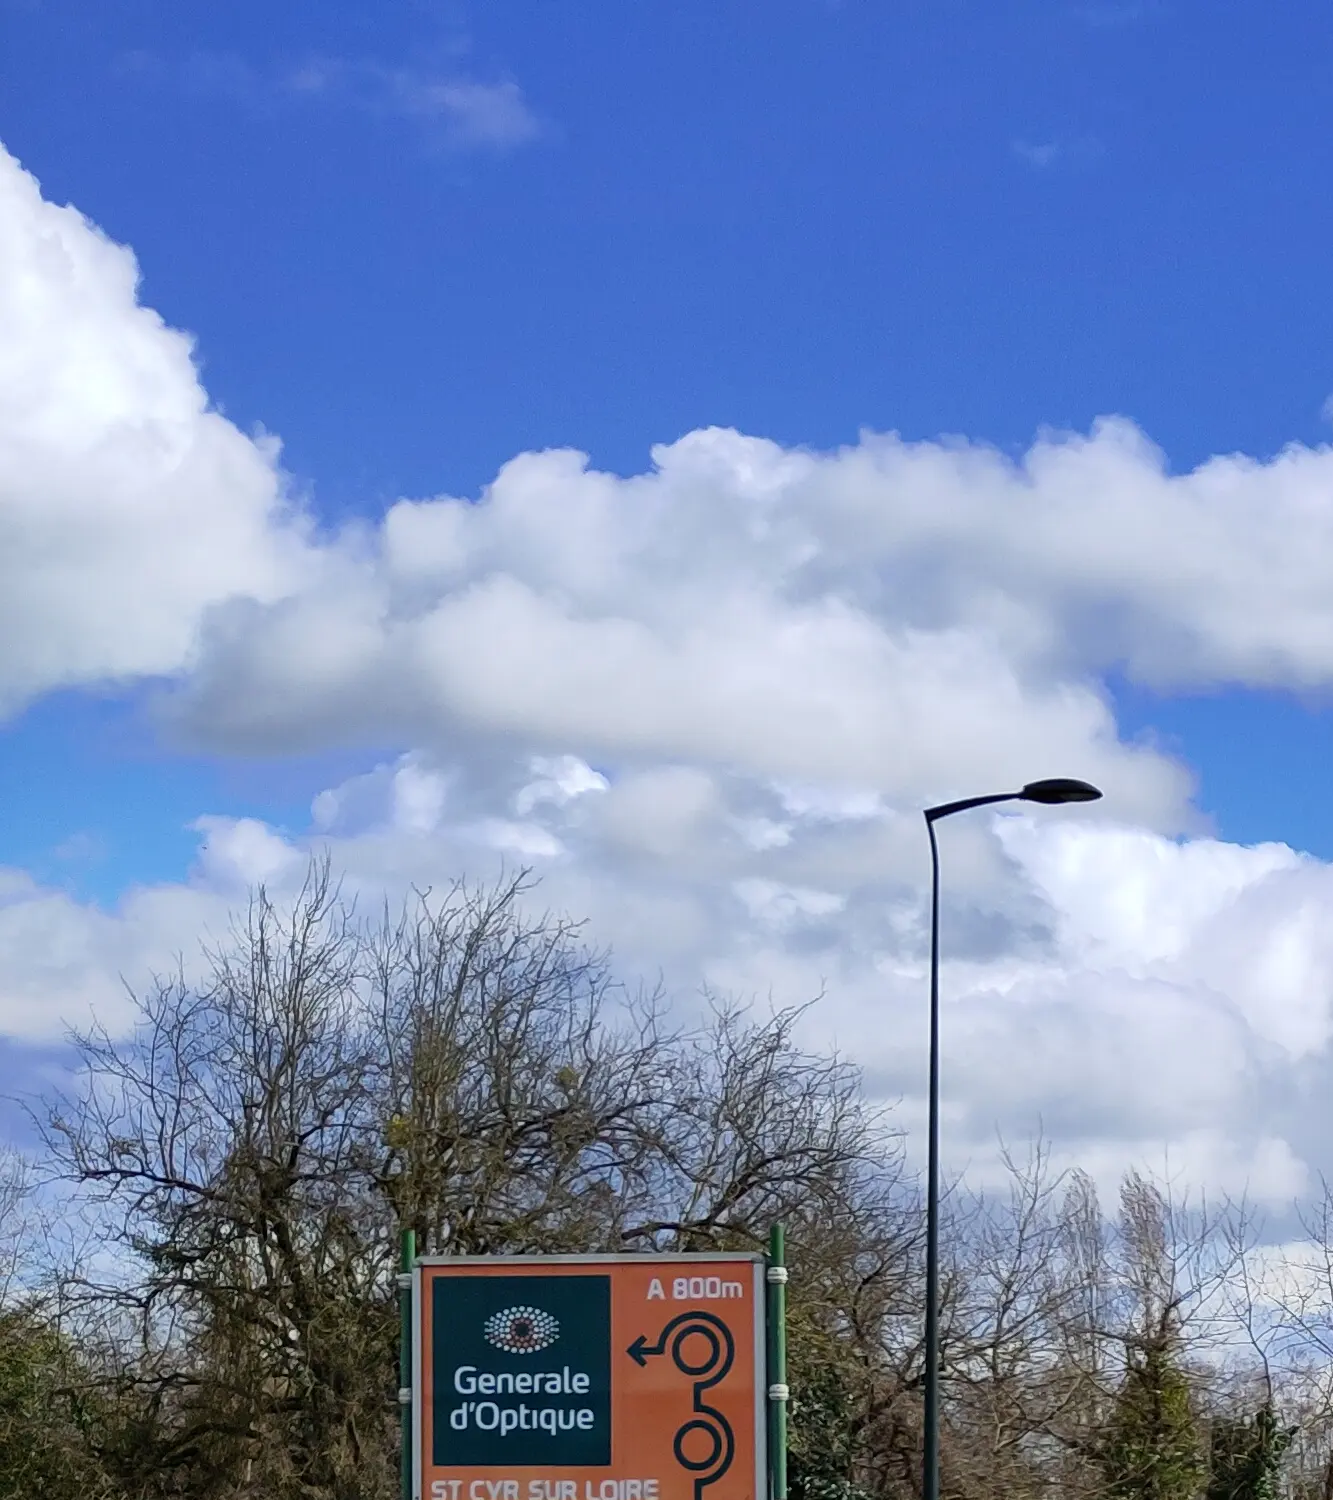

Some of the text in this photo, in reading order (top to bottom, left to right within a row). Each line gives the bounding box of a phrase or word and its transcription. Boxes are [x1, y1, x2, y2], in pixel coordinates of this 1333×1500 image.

[647, 1277, 743, 1300] A 800m
[453, 1365, 591, 1395] Generale
[449, 1401, 595, 1437] d'Optique
